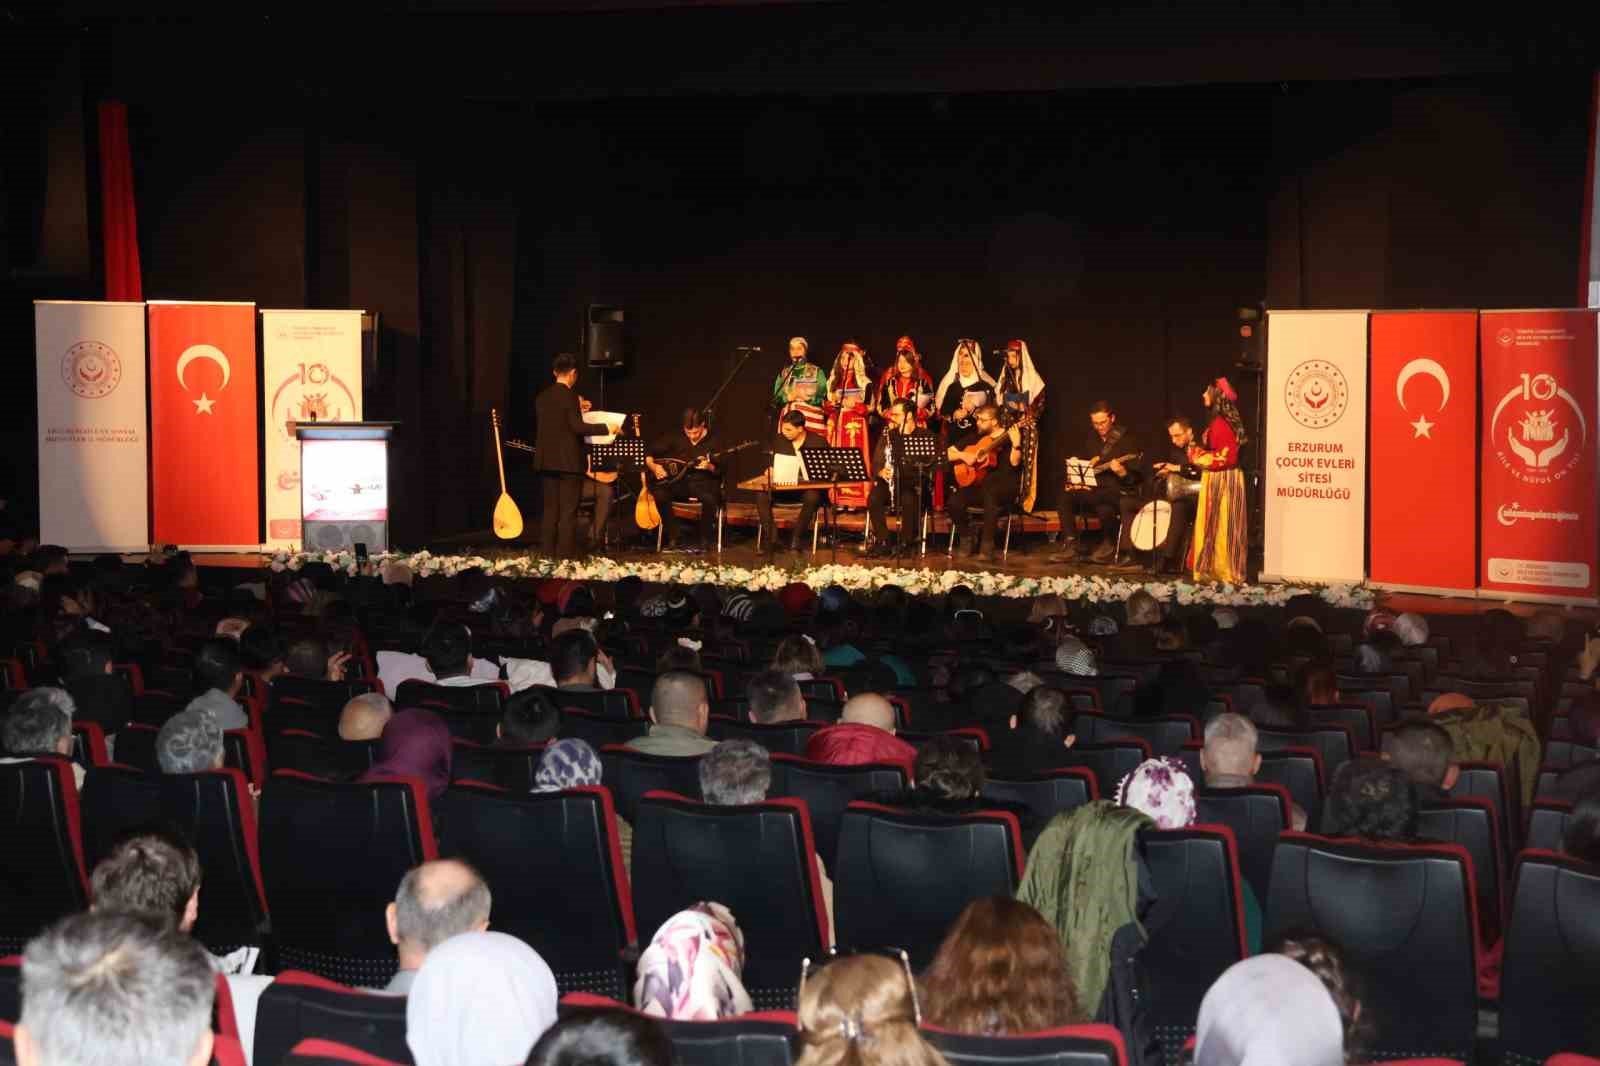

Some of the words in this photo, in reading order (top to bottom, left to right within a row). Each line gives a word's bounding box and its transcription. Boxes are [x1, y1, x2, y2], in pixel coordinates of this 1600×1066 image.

[298, 362, 329, 384] 10
[1520, 373, 1557, 401] 10
[1288, 442, 1343, 453] ERZURUM
[1276, 457, 1314, 469] ÇOCUK
[1317, 458, 1355, 469] EVLERİ
[1298, 471, 1332, 484] SİTESİ
[1276, 486, 1351, 500] MÜDÜRLÜĞÜ
